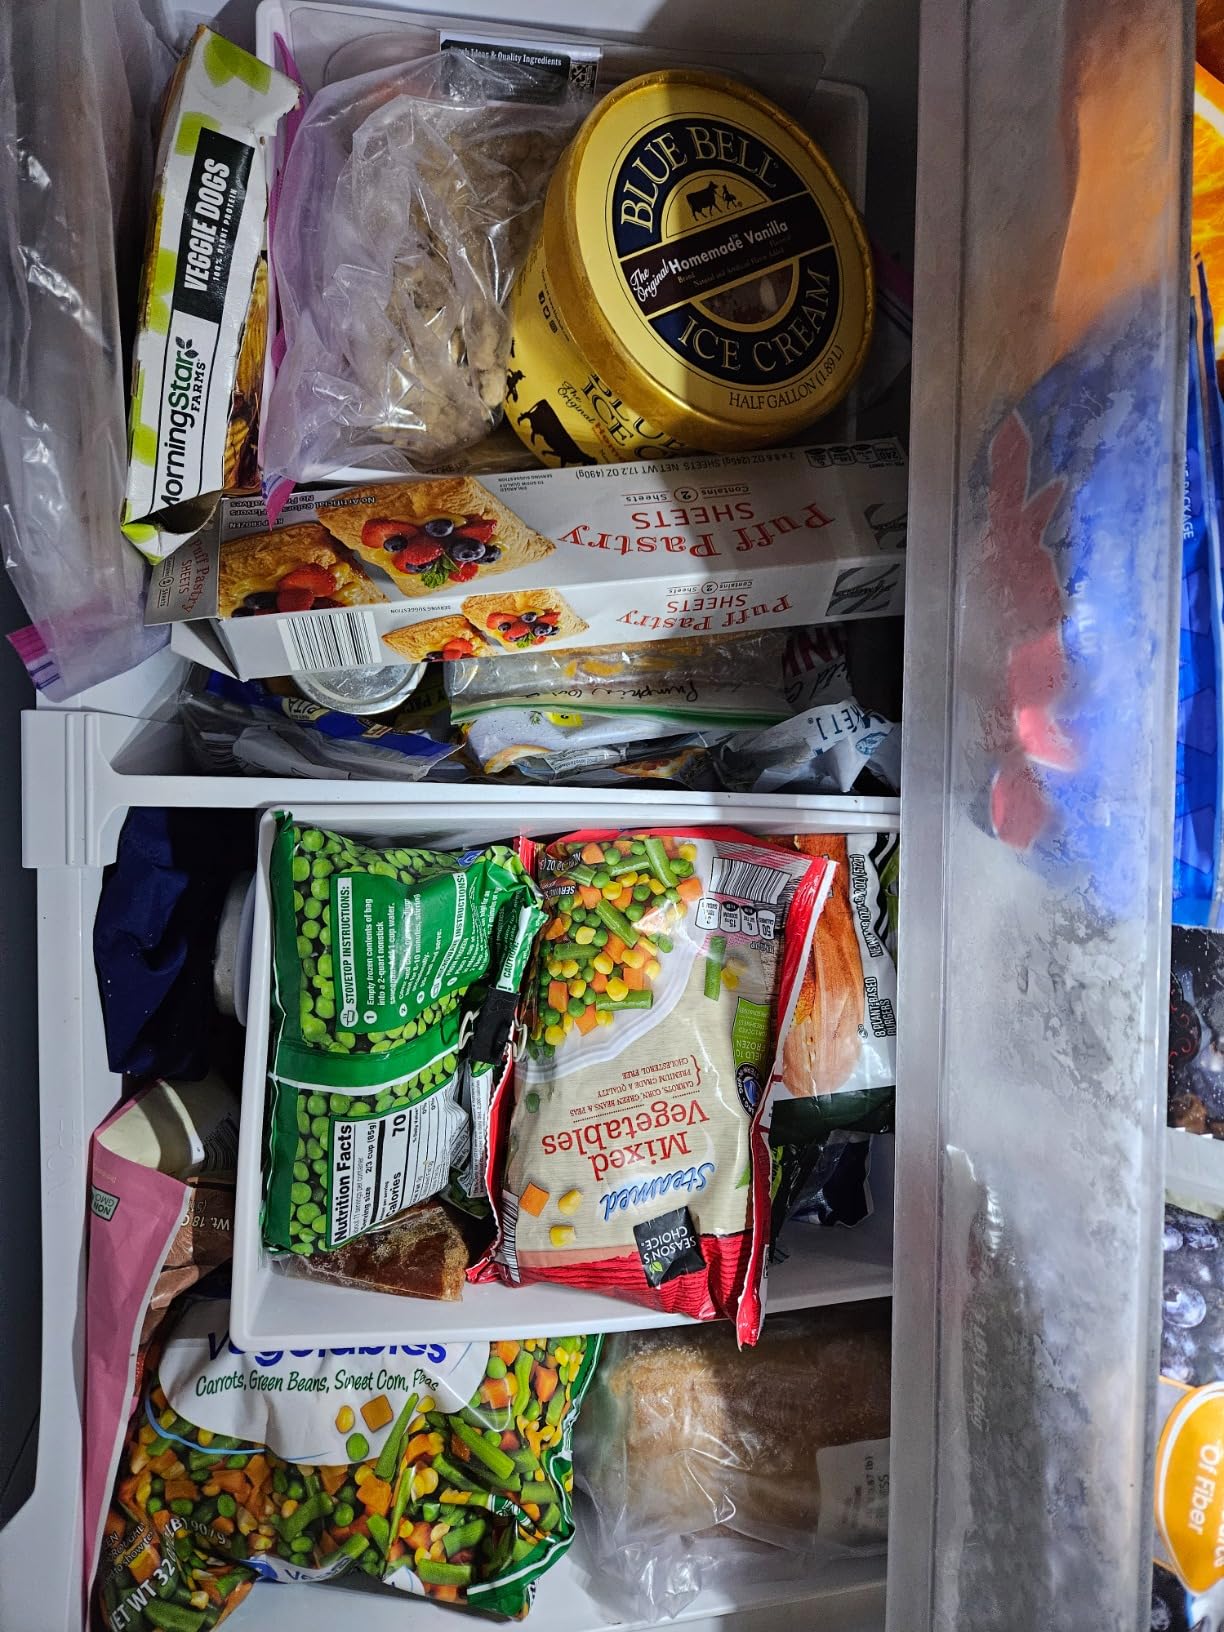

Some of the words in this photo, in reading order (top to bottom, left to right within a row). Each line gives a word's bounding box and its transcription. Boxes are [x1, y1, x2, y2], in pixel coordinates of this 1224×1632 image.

[497, 51, 522, 63] Quality
[522, 54, 562, 68] Ingredients
[195, 157, 231, 220] DOGS
[621, 132, 687, 233] BLUE
[685, 127, 779, 189] BELL
[223, 188, 238, 225] PROTEIN
[217, 227, 229, 254] PLANT
[184, 218, 218, 291] VEGGIE
[637, 263, 671, 302] Original
[669, 236, 745, 276] Homemade
[744, 219, 788, 248] Vanilla
[212, 257, 224, 281] 100%
[630, 267, 650, 288] The
[678, 316, 741, 371] ICE
[752, 267, 830, 372] CREAM
[191, 362, 206, 412] FARMS
[561, 380, 582, 401] The
[729, 391, 766, 411] HALF
[767, 373, 818, 409] GALLON
[816, 352, 838, 394] (1.89
[560, 387, 596, 425] Original
[582, 381, 635, 448] ICE
[575, 468, 604, 480] (490g)
[605, 467, 618, 477] OZ
[620, 465, 638, 475] 17.2
[641, 464, 659, 473] WT
[660, 462, 679, 472] NET
[683, 458, 720, 469] SHEETS
[230, 496, 298, 508] Prvatives
[360, 496, 375, 505] No
[625, 492, 669, 502] Sheets
[680, 490, 692, 501] 2
[701, 486, 750, 497] Contains
[229, 507, 267, 517] Flavors
[281, 503, 314, 512] Colors
[315, 498, 359, 509] Artificial
[228, 520, 262, 529] FROZEN
[631, 502, 754, 530] SHEETS
[726, 503, 835, 554] Puff
[558, 524, 721, 558] Pastry
[179, 559, 192, 593] SHEETS
[719, 580, 753, 590] Contains
[160, 589, 168, 607] Sheets
[181, 565, 210, 614] Pastry
[667, 586, 698, 594] Sheets
[667, 594, 747, 613] SHEETS
[721, 593, 793, 628] Puff
[616, 610, 711, 631] Pastry
[364, 898, 373, 913] bag
[413, 893, 422, 920] stirring
[455, 874, 464, 938] INSTRUCTIONS:
[341, 886, 352, 956] INSTRUCTIONS:
[364, 914, 372, 922] of
[365, 923, 373, 957] contents
[376, 921, 385, 954] nonstick
[388, 928, 396, 943] cup
[414, 922, 422, 953] minutes,
[434, 928, 442, 950] serve.
[761, 924, 772, 936] 50
[366, 957, 374, 981] frozen
[377, 955, 387, 984] 2-quart
[412, 954, 421, 971] 8-10
[502, 940, 519, 979] CAUTION:
[344, 960, 354, 1004] STOVETOP
[366, 981, 375, 1006] Empty
[377, 991, 386, 1006] into
[864, 976, 880, 1028] PLANT-BASED
[880, 999, 896, 1036] BURGERS
[735, 1039, 767, 1052] FROZEN
[622, 1070, 639, 1079] FREE
[641, 1057, 688, 1075] CHOLESTEROL
[659, 1069, 691, 1082] PREMIUM
[598, 1084, 627, 1098] QUALITY
[635, 1078, 657, 1088] GRADE
[661, 1081, 694, 1094] CARROTS,
[616, 1093, 640, 1104] GREEN
[641, 1089, 661, 1099] CORN,
[570, 1107, 586, 1116] PEAS
[593, 1100, 616, 1111] BEANS
[366, 1121, 377, 1143] (85g)
[392, 1113, 407, 1137] 70
[541, 1099, 710, 1156] Vegetables
[337, 1124, 353, 1172] Facts
[366, 1144, 375, 1159] cup
[589, 1130, 692, 1181] Mixed
[365, 1160, 373, 1174] 2/3
[363, 1186, 371, 1202] size
[386, 1171, 402, 1218] Calories
[600, 1162, 716, 1222] Steamed
[93, 1202, 112, 1215] NON
[334, 1176, 350, 1242] Nutrition
[360, 1203, 370, 1231] Serving
[192, 1215, 205, 1228] 18
[210, 1216, 230, 1231] Wt.
[643, 1235, 697, 1264] SEASON'S
[196, 1374, 247, 1397] Carrots,
[249, 1371, 283, 1392] Green
[287, 1370, 329, 1393] Beans,
[334, 1370, 373, 1391] Sweet
[376, 1370, 410, 1392] Corn,
[1189, 1475, 1215, 1535] Fiber
[125, 1578, 160, 1613] WT
[150, 1558, 179, 1587] 32
